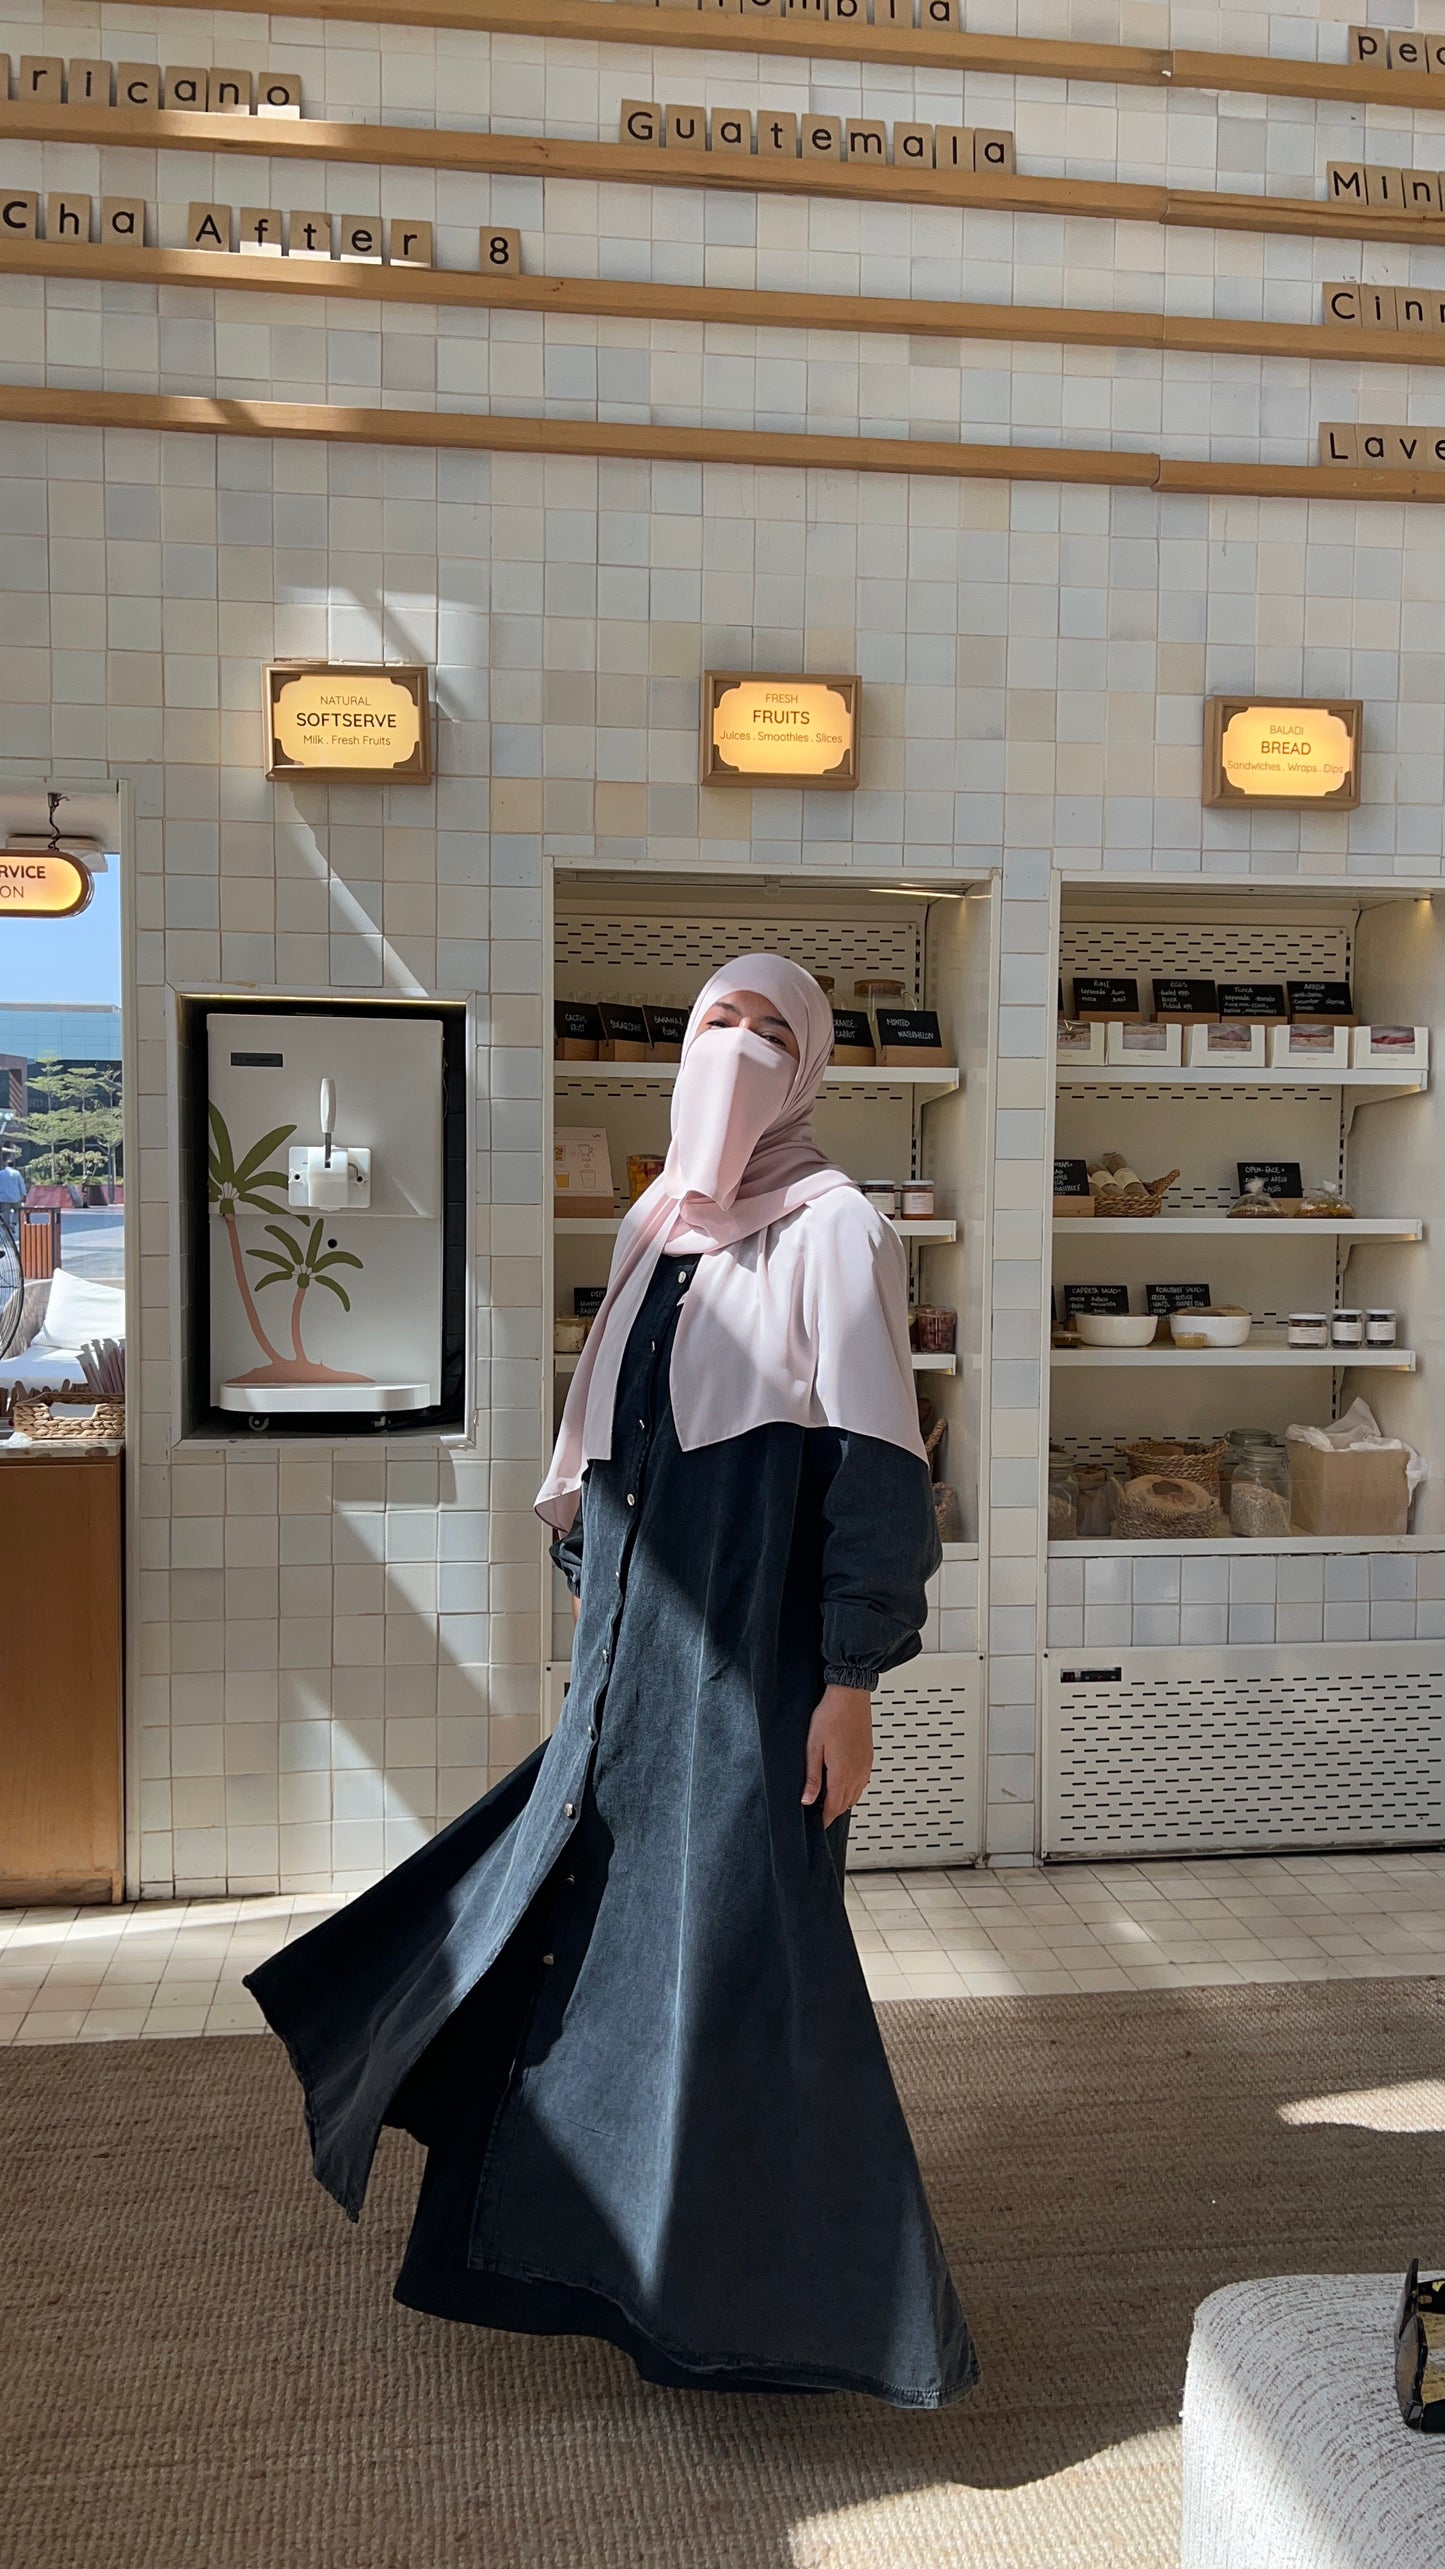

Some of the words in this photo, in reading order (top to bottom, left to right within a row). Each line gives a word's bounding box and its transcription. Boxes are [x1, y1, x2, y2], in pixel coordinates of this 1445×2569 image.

[32, 68, 290, 106] ricano
[627, 111, 1005, 164] Guatemala
[1333, 170, 1431, 202] Min
[195, 213, 418, 256] After
[489, 236, 509, 265] 8
[320, 695, 371, 706] NATURAL
[765, 693, 798, 704] FRESH
[296, 712, 397, 728] SOFTSERVE
[753, 709, 810, 725] FRUITS
[720, 730, 750, 741] Juices
[757, 731, 808, 742] Smoothies
[815, 732, 843, 743] Slices
[1269, 725, 1304, 735] BALADI
[303, 735, 323, 745] Milk
[332, 735, 360, 745] Fresh
[363, 736, 391, 746] Fruits
[1261, 741, 1311, 755] BREAD
[1227, 760, 1281, 771] Sandwiches
[1287, 763, 1317, 774] Wraps
[1323, 763, 1344, 774] Dips
